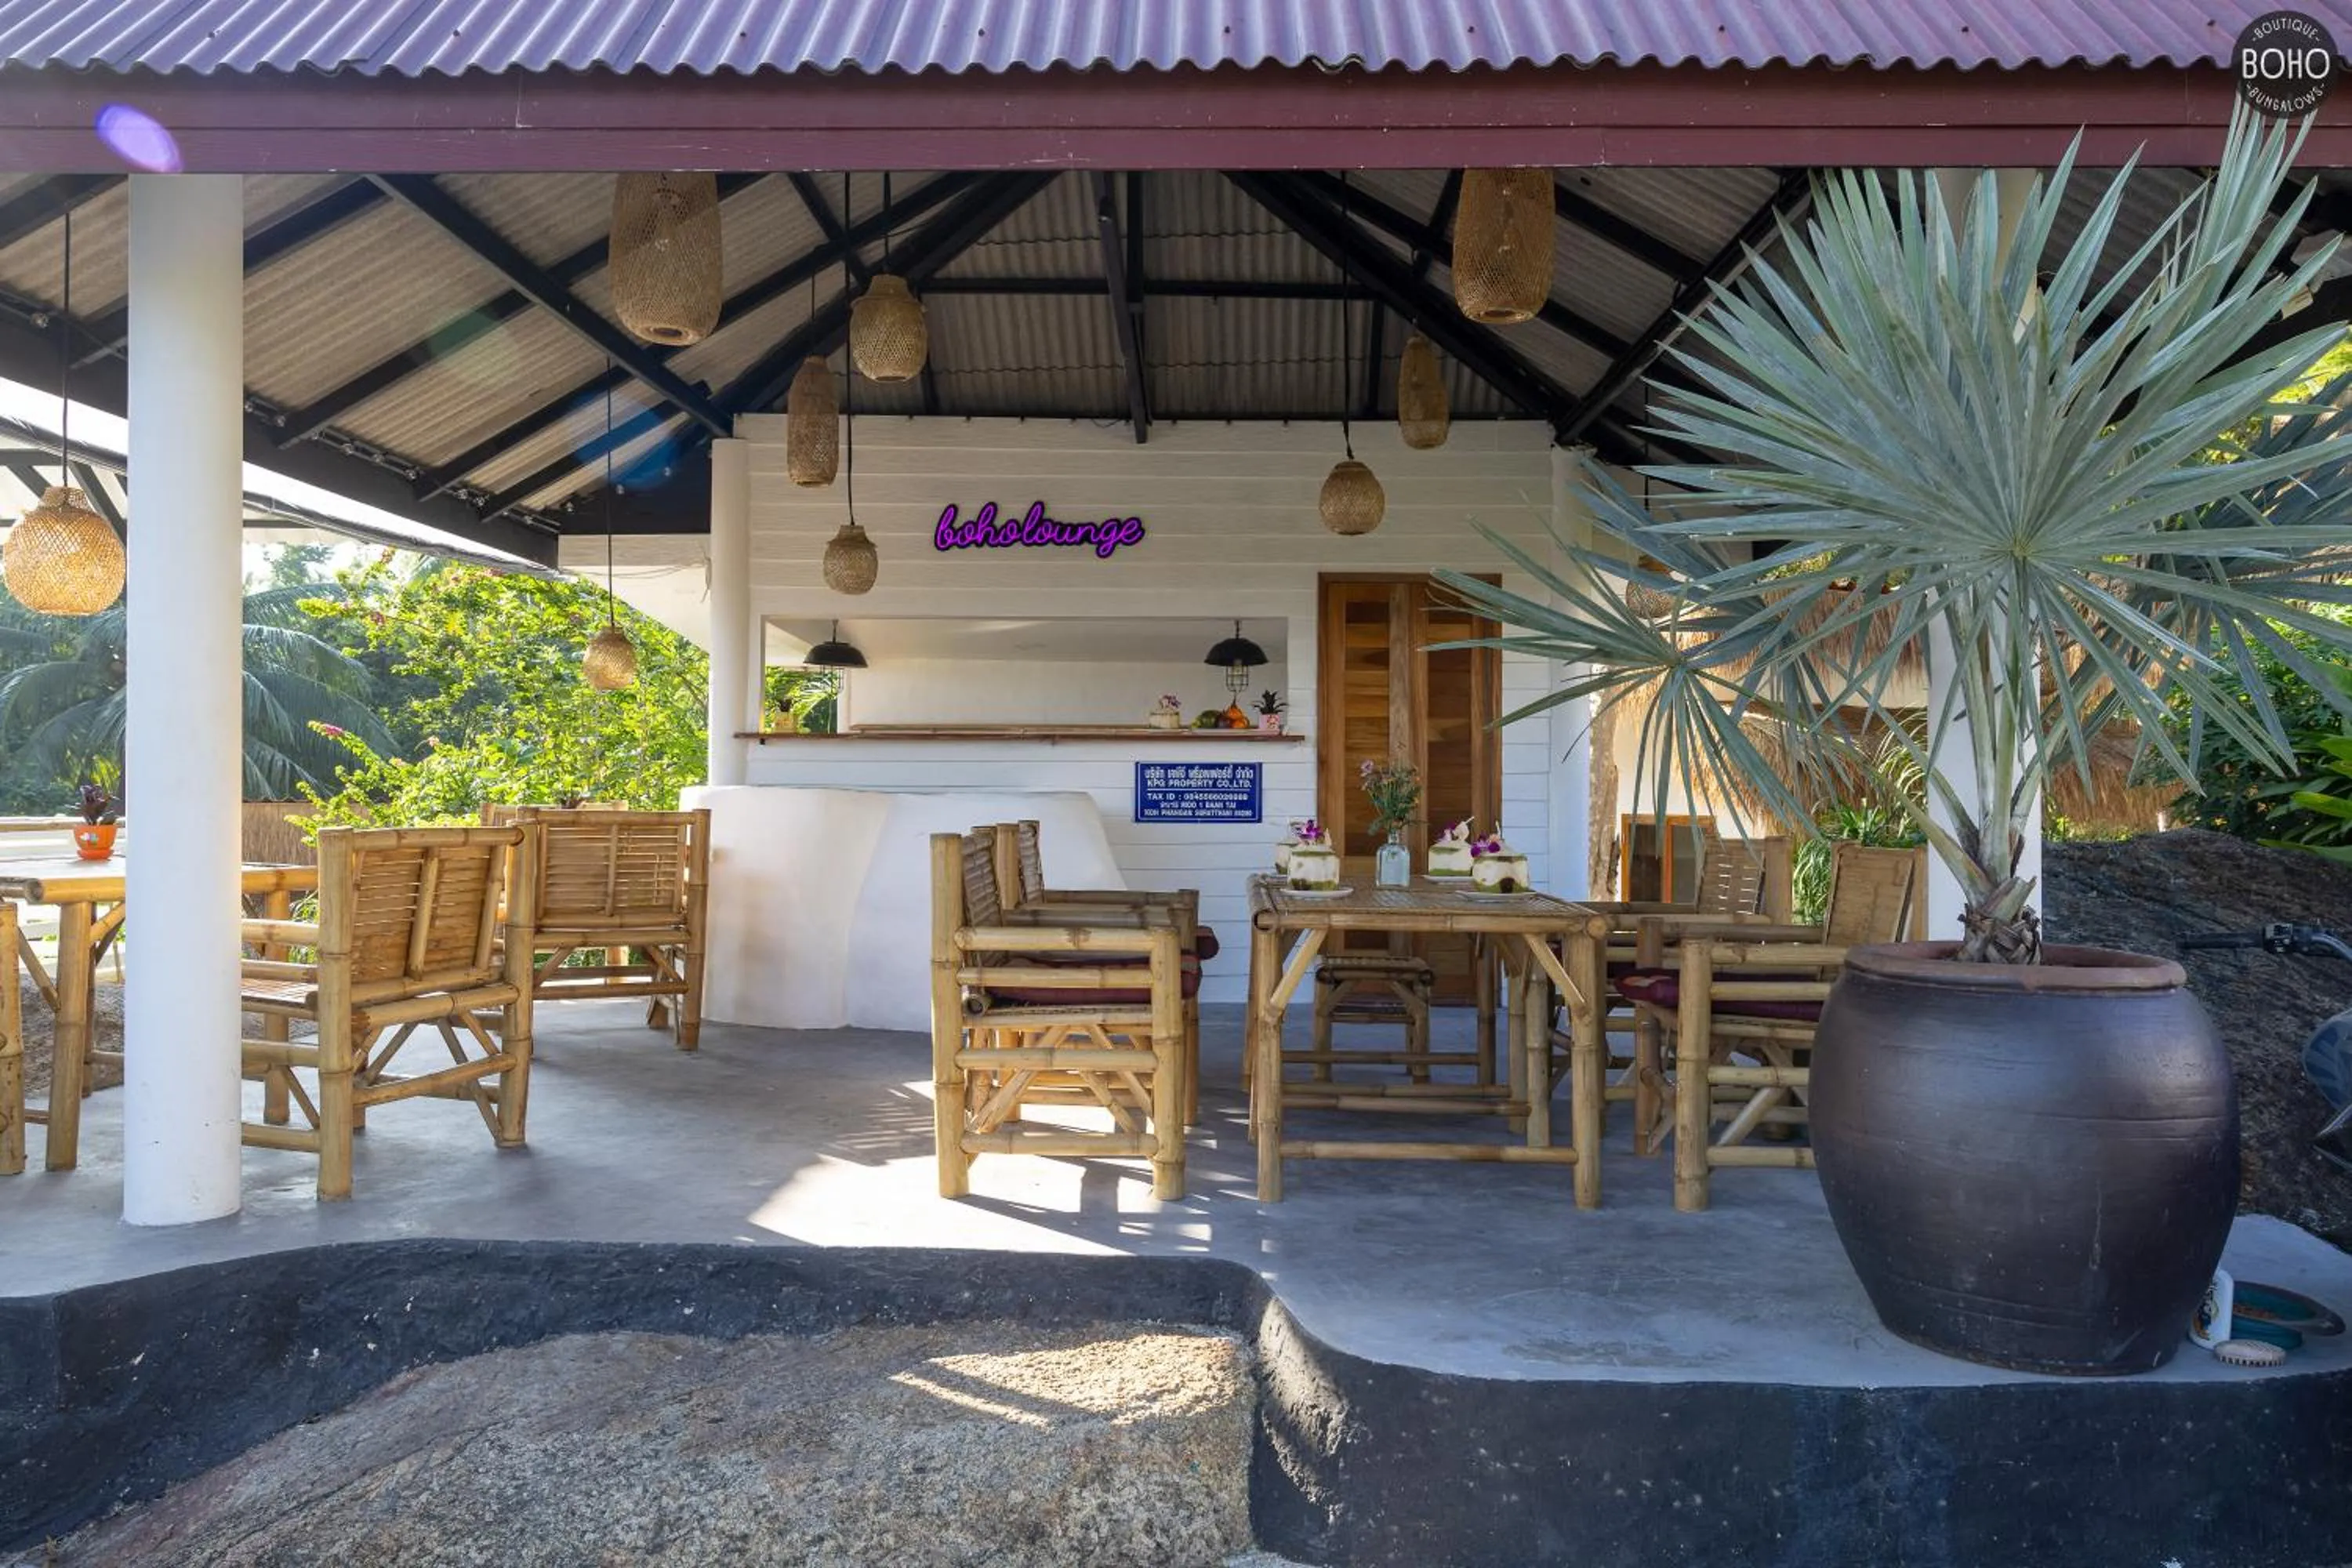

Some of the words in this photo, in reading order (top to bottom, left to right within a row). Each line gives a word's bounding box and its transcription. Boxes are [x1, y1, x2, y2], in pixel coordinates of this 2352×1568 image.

[935, 500, 1145, 558] boholounge
[1147, 779, 1165, 787] KPG
[1167, 779, 1214, 787] PROPERTY
